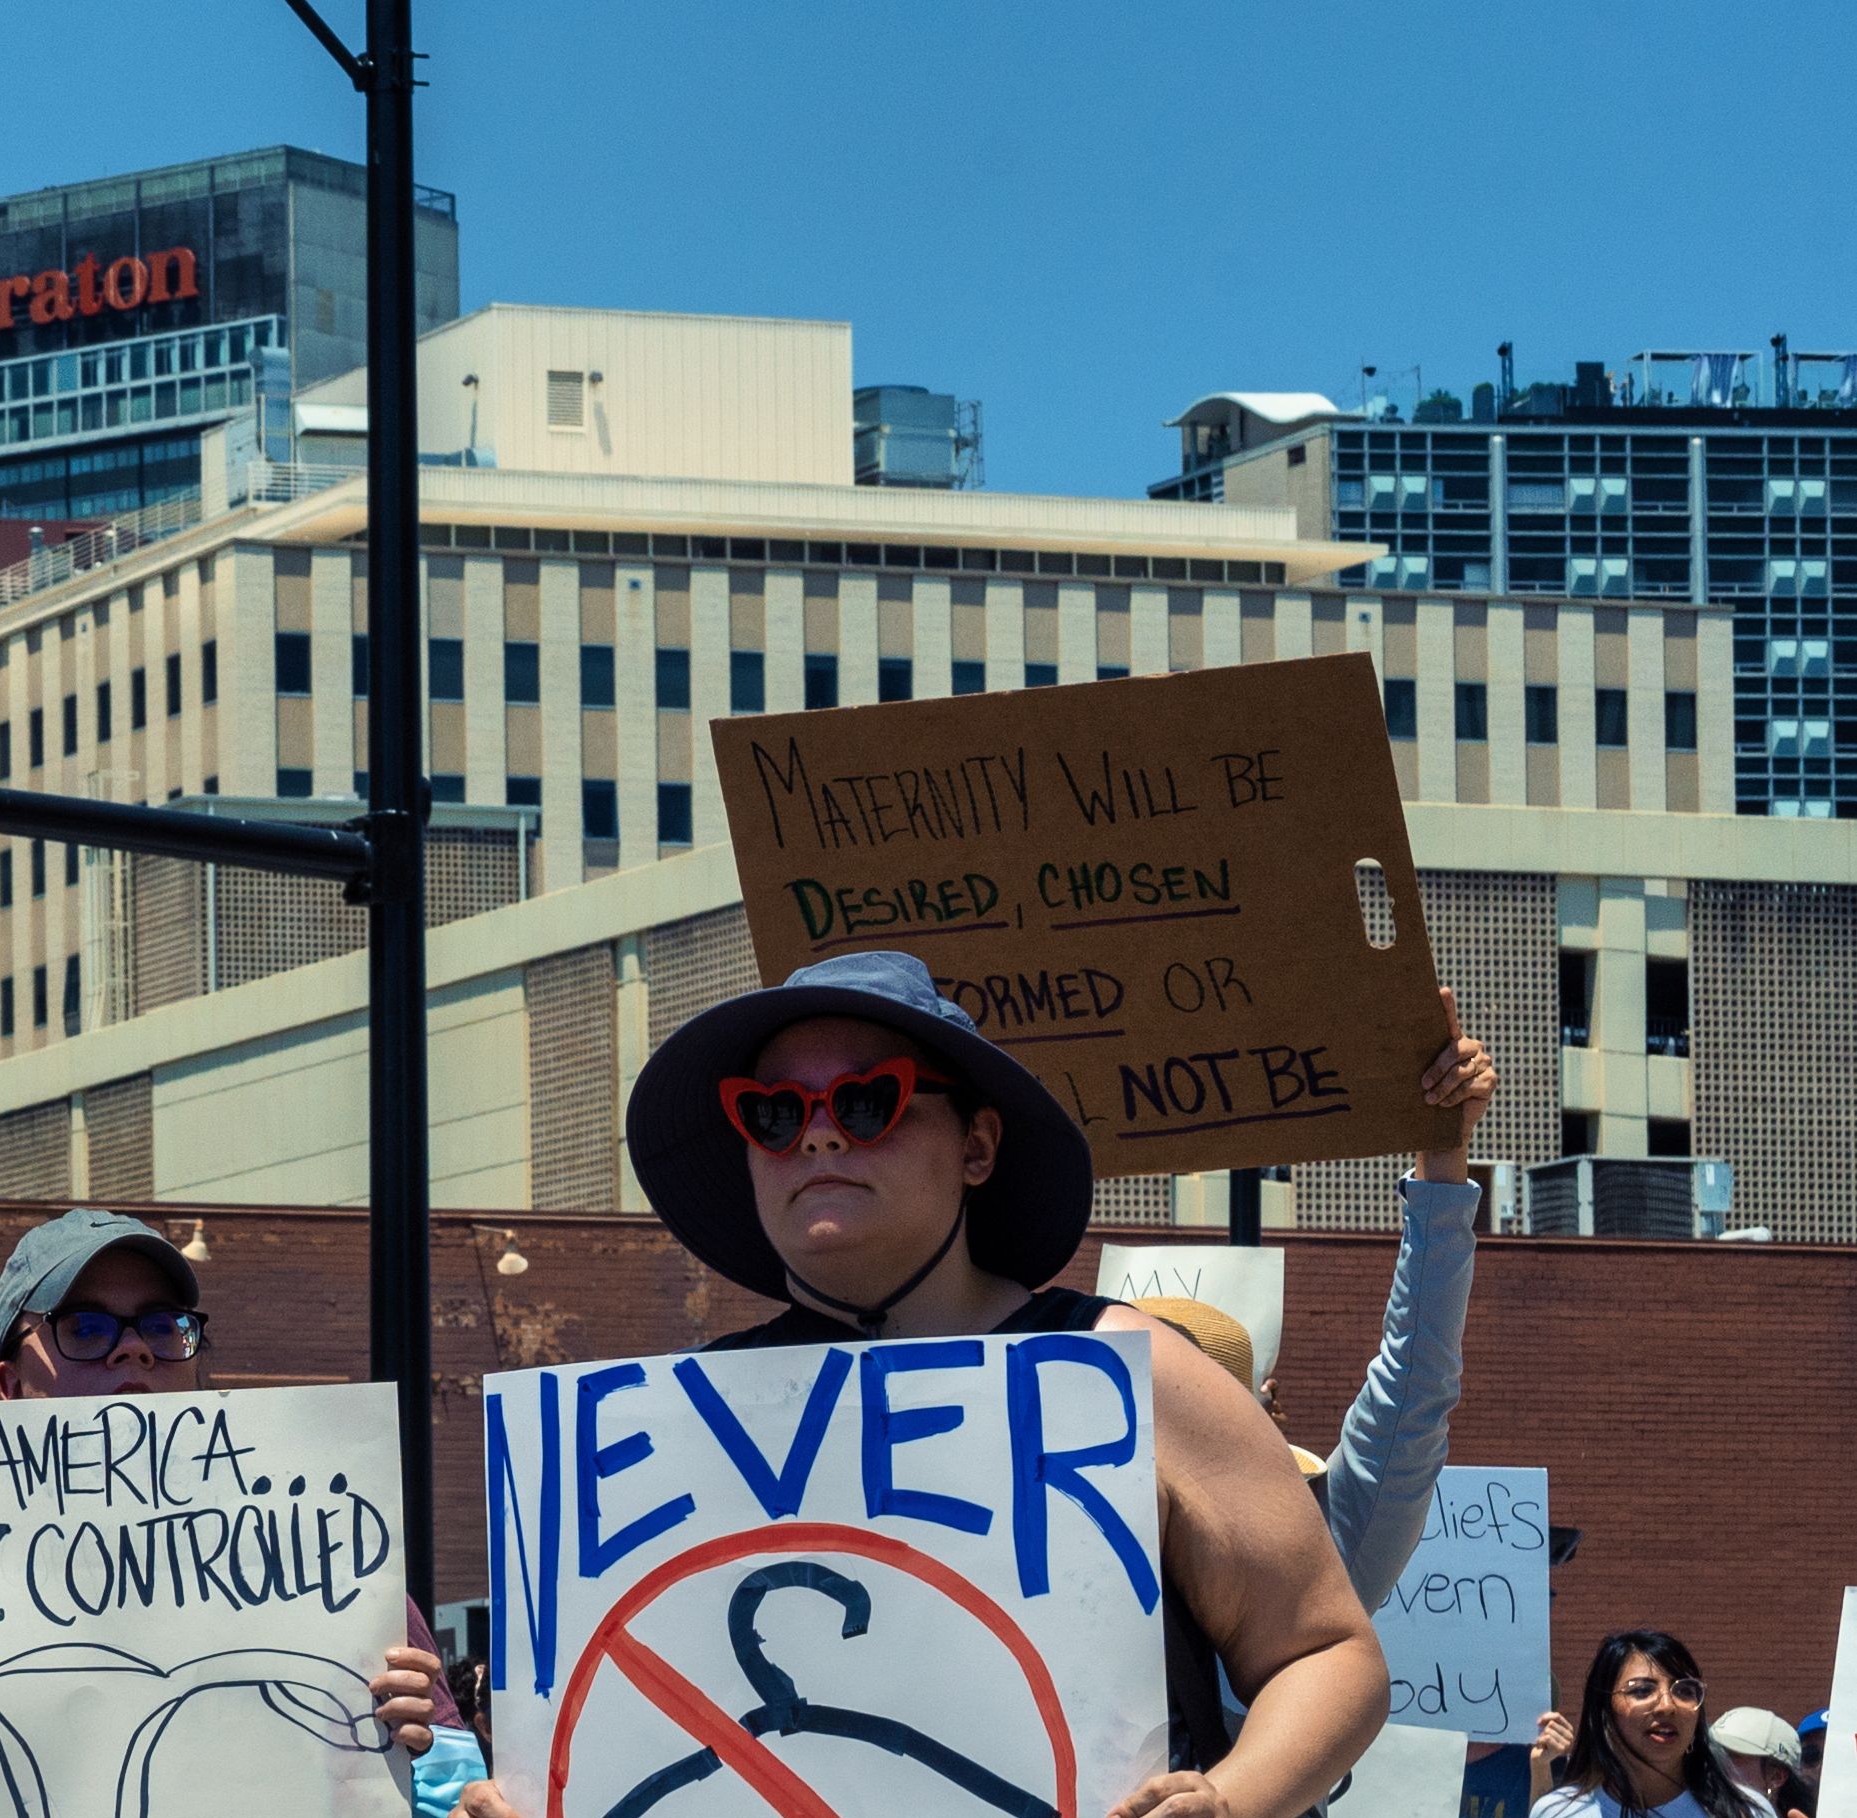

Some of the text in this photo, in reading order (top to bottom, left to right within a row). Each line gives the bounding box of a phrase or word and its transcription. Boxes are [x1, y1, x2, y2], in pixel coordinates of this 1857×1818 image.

[751, 737, 1287, 850] MATERNITY WILL BE
[1037, 859, 1232, 912] CHOSEN
[1164, 957, 1253, 1013] OR
[1119, 1049, 1239, 1121] NOT
[1248, 1045, 1348, 1108] BE
[485, 1336, 1160, 1696] NEVER
[26, 1491, 391, 1628] CONTROLLED
[1379, 1573, 1516, 1623] vern
[1390, 1662, 1508, 1735] ody
